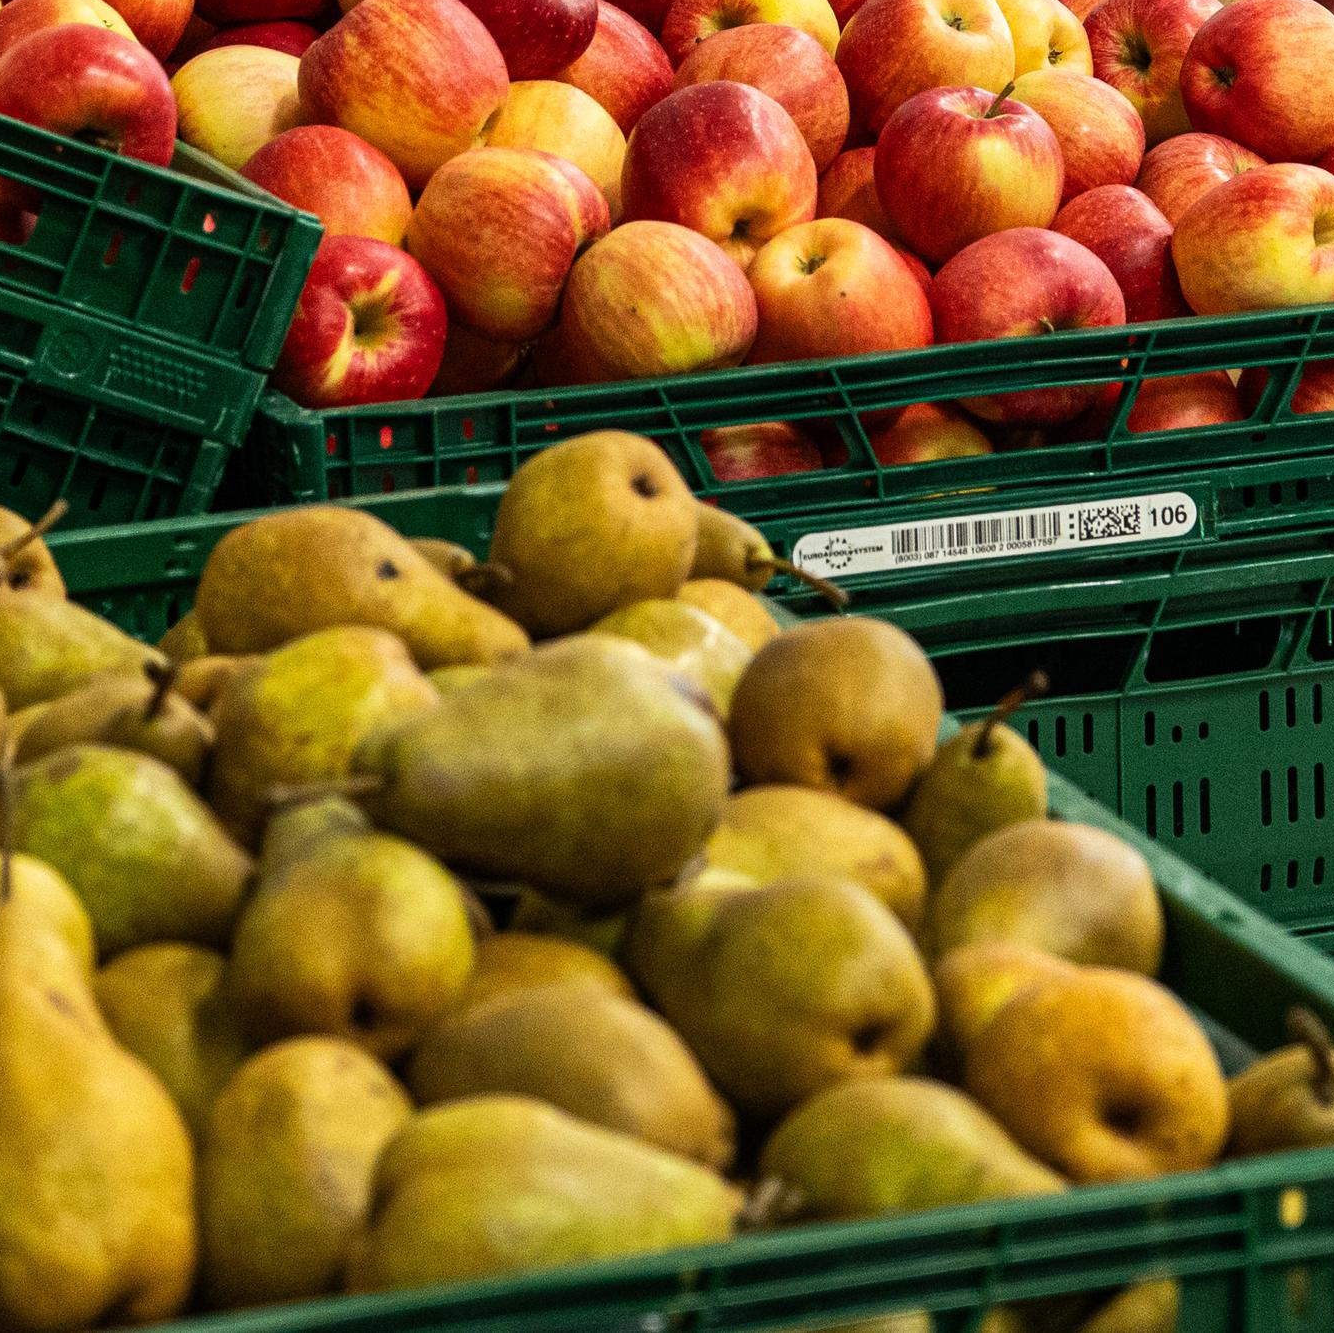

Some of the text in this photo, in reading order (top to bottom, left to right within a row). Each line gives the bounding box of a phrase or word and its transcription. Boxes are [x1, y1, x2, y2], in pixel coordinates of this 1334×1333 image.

[1150, 504, 1188, 527] 106
[854, 545, 883, 555] SYSTEM
[895, 537, 1058, 565] (8003) 087 14548 10600 2 0005817597
